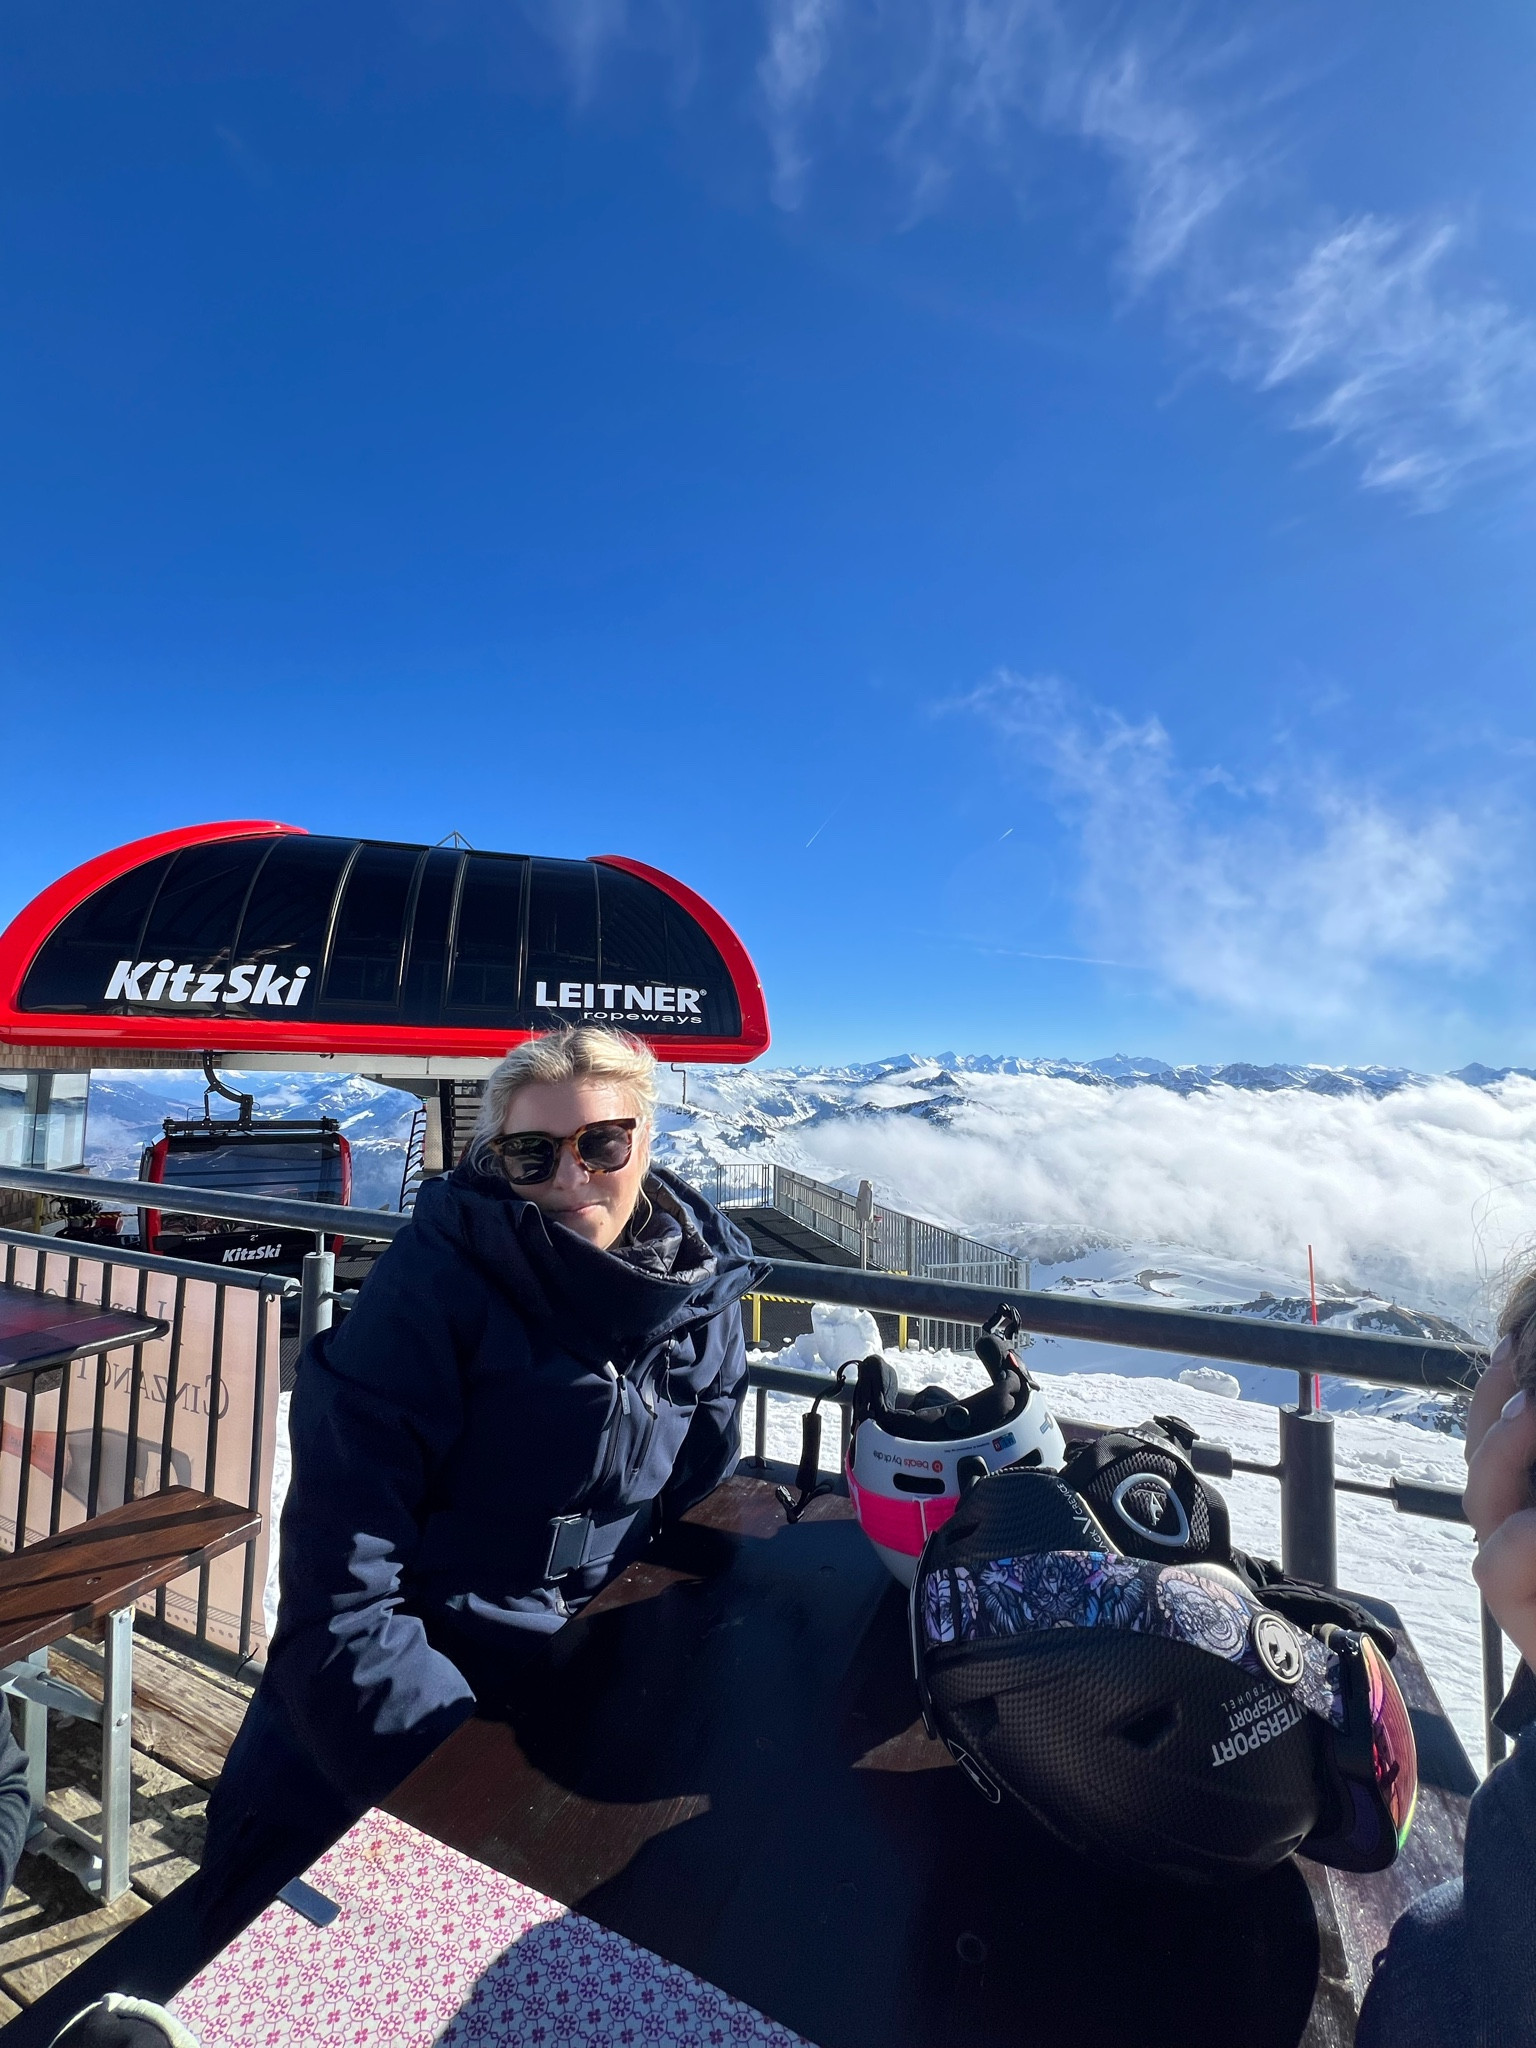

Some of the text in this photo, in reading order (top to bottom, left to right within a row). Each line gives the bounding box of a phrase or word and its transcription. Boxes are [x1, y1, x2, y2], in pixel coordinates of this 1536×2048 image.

[104, 958, 311, 1006] KitzSki
[583, 1011, 702, 1025] ropeways
[222, 1243, 282, 1263] KitzSki
[903, 1458, 929, 1471] beats
[1056, 1482, 1083, 1515] CREVICE
[1089, 1529, 1110, 1555] LACK
[1212, 1699, 1308, 1767] NTERSPORT
